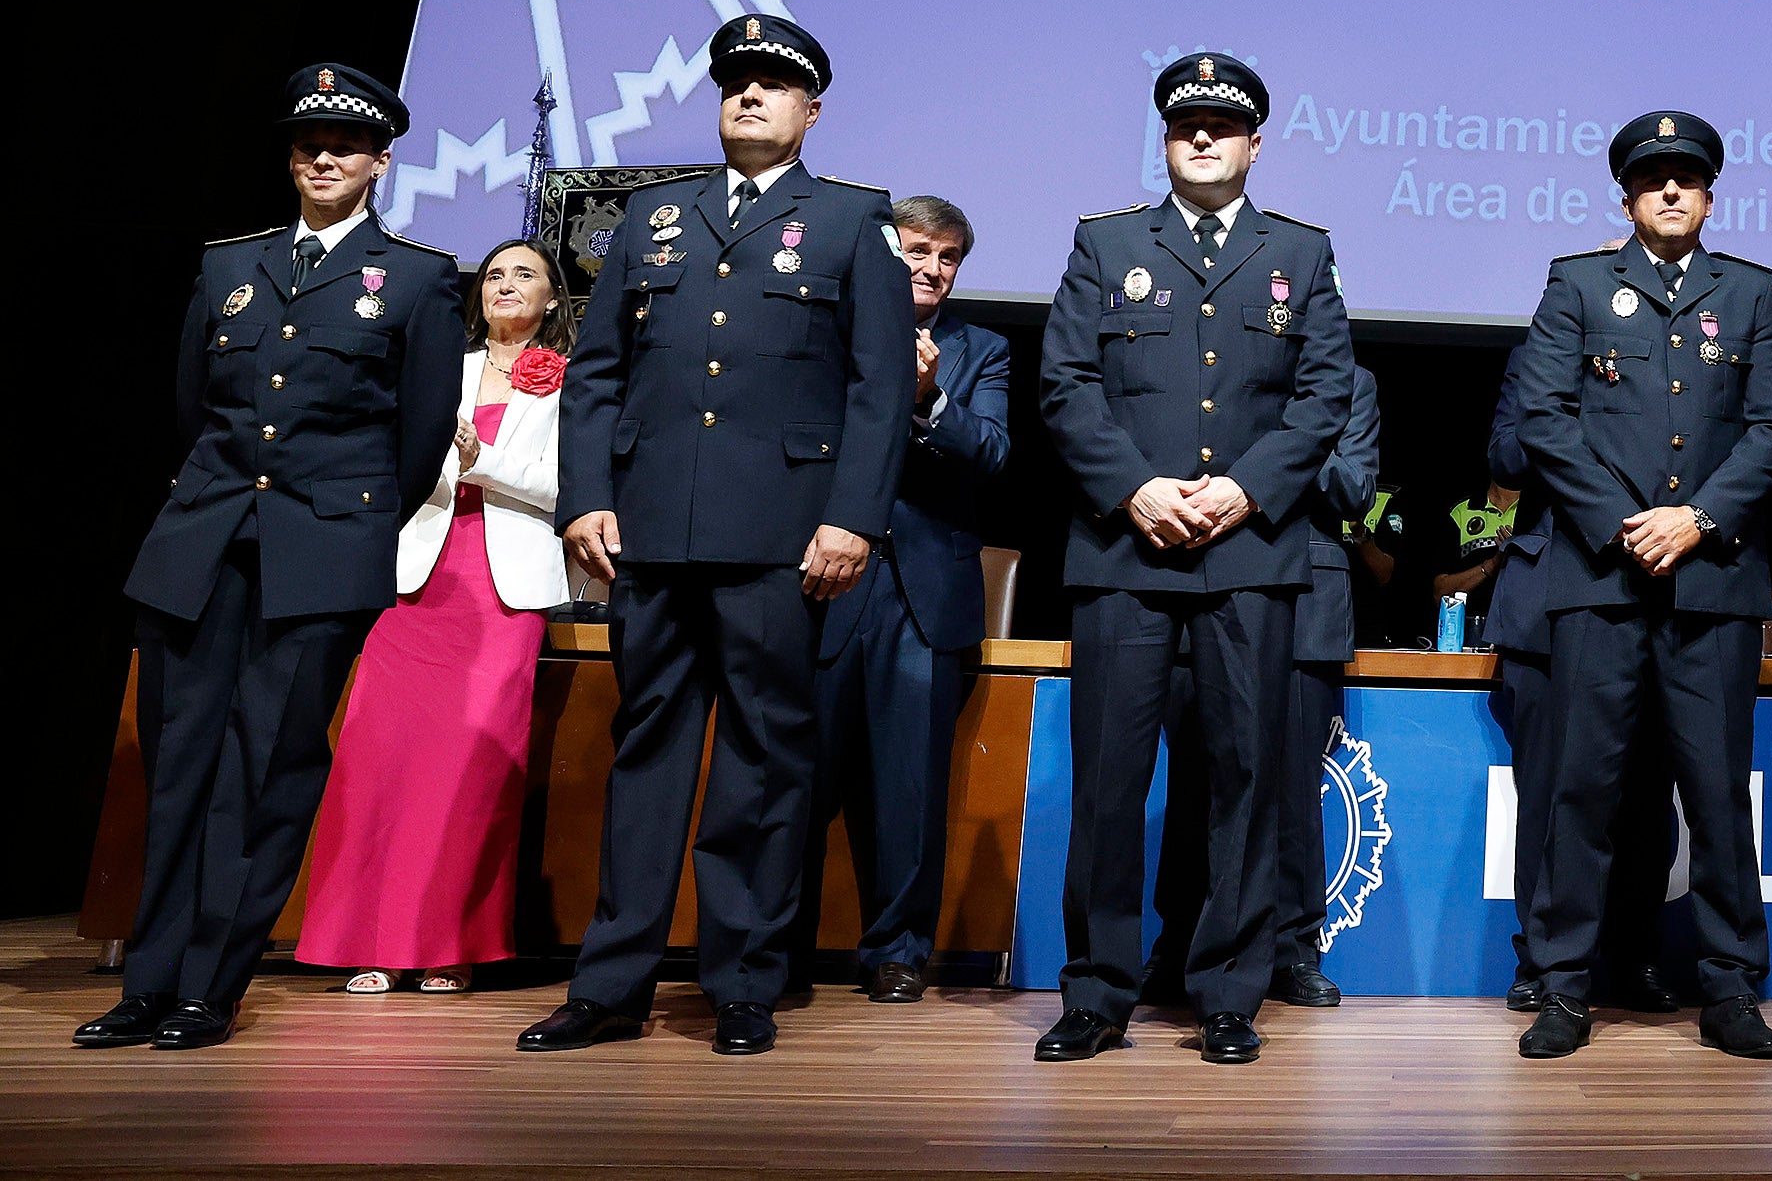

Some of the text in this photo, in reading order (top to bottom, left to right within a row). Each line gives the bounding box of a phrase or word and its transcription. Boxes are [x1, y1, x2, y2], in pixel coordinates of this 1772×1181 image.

[1281, 93, 1622, 157] Ayuntamie
[1385, 157, 1508, 221] Área
[1525, 177, 1590, 225] de
